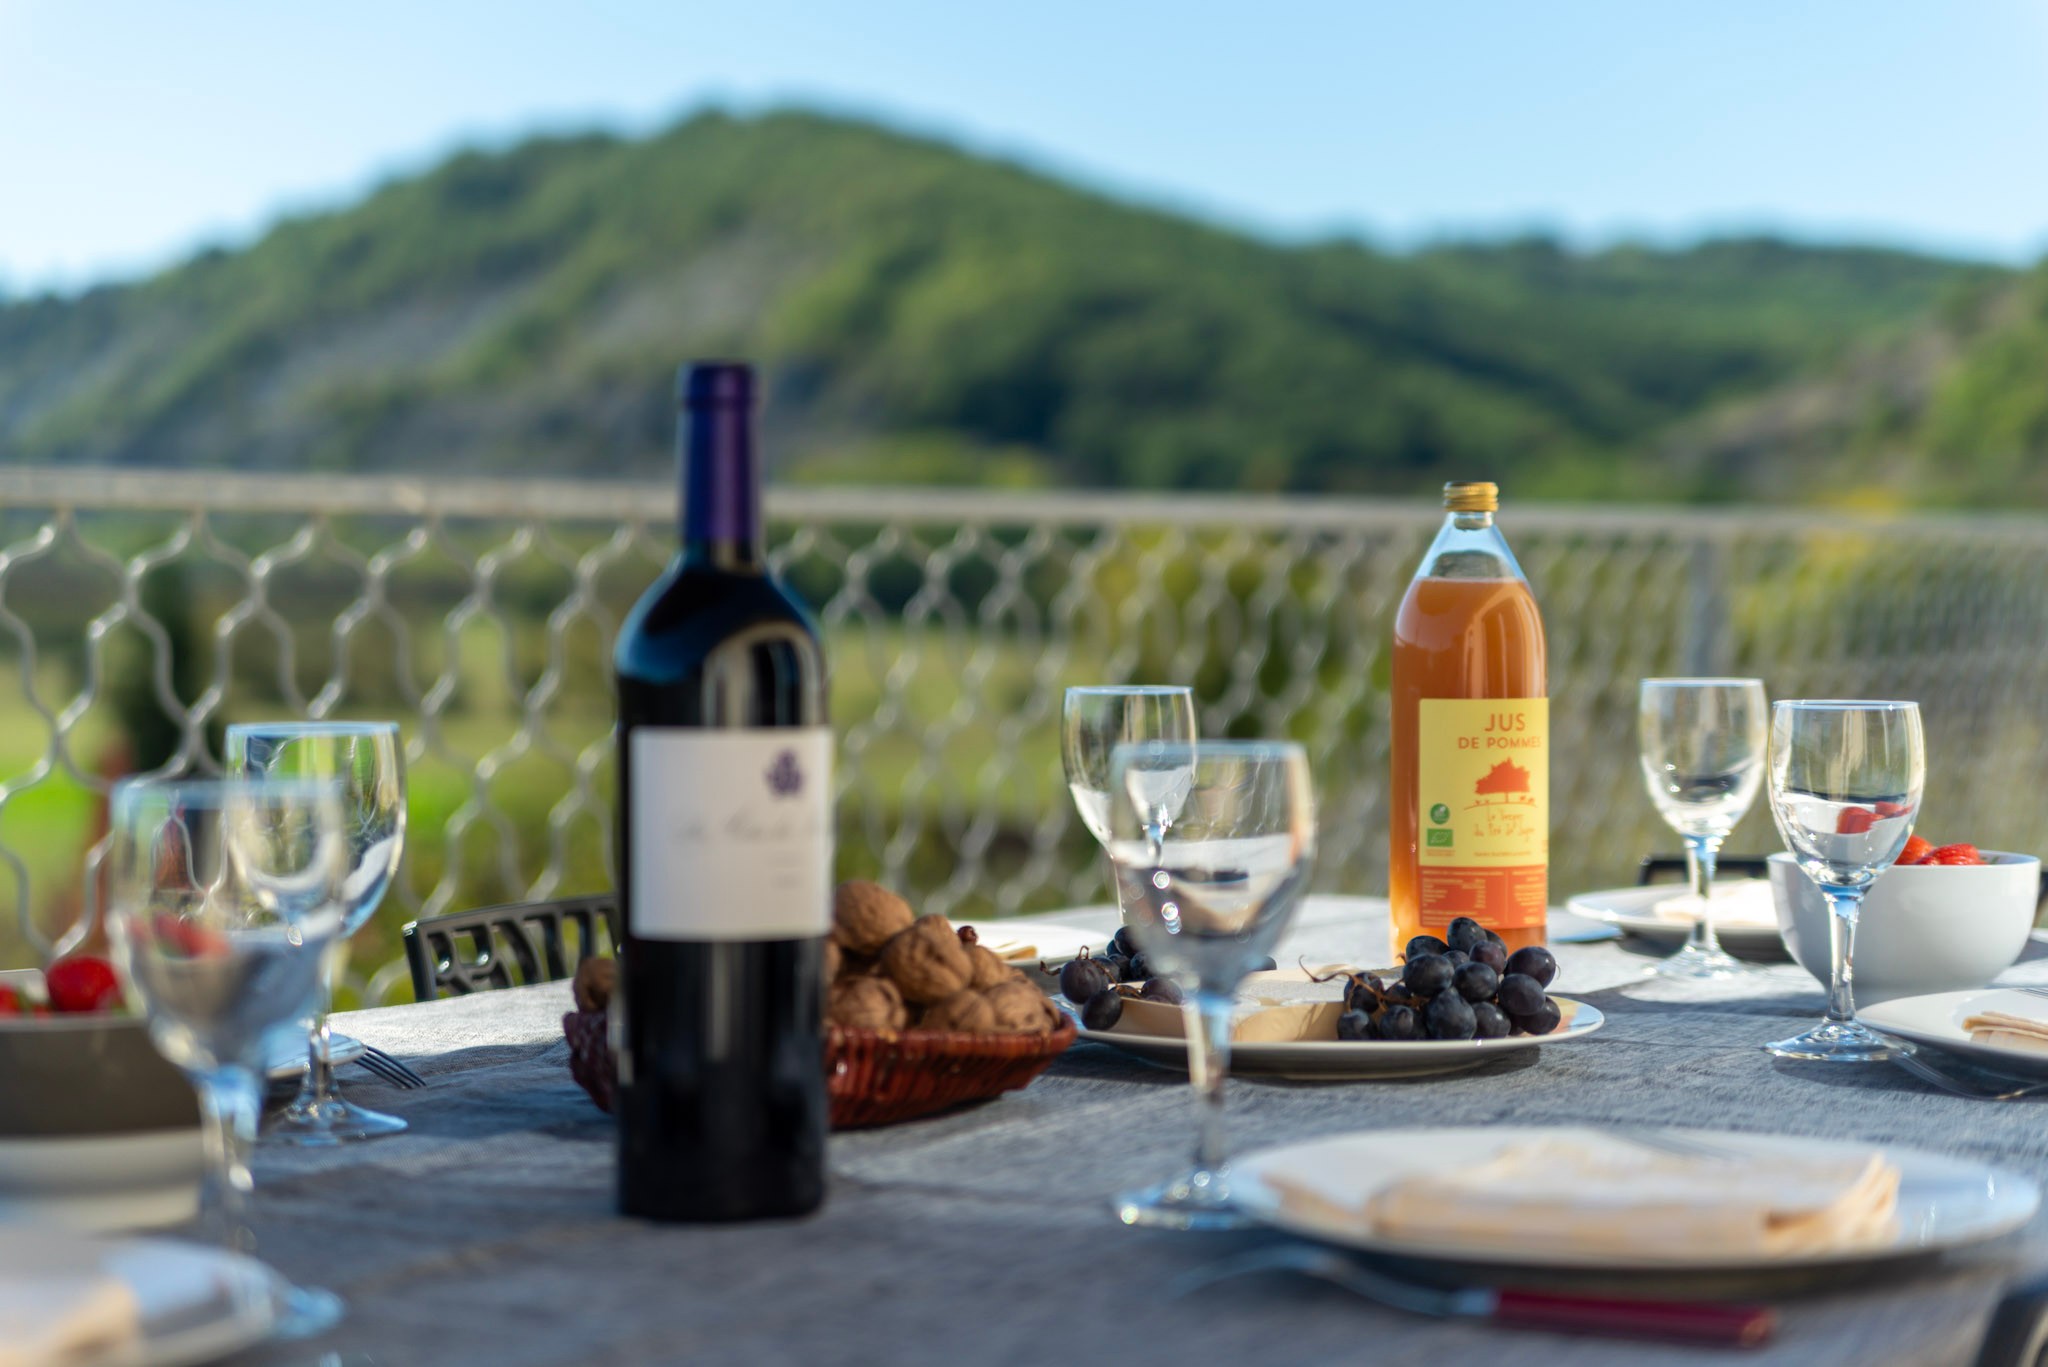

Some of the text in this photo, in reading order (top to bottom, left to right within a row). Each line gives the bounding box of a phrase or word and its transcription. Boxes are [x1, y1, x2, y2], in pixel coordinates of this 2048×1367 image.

[1484, 713, 1525, 732] JUS
[1458, 736, 1541, 750] DE POMMES
